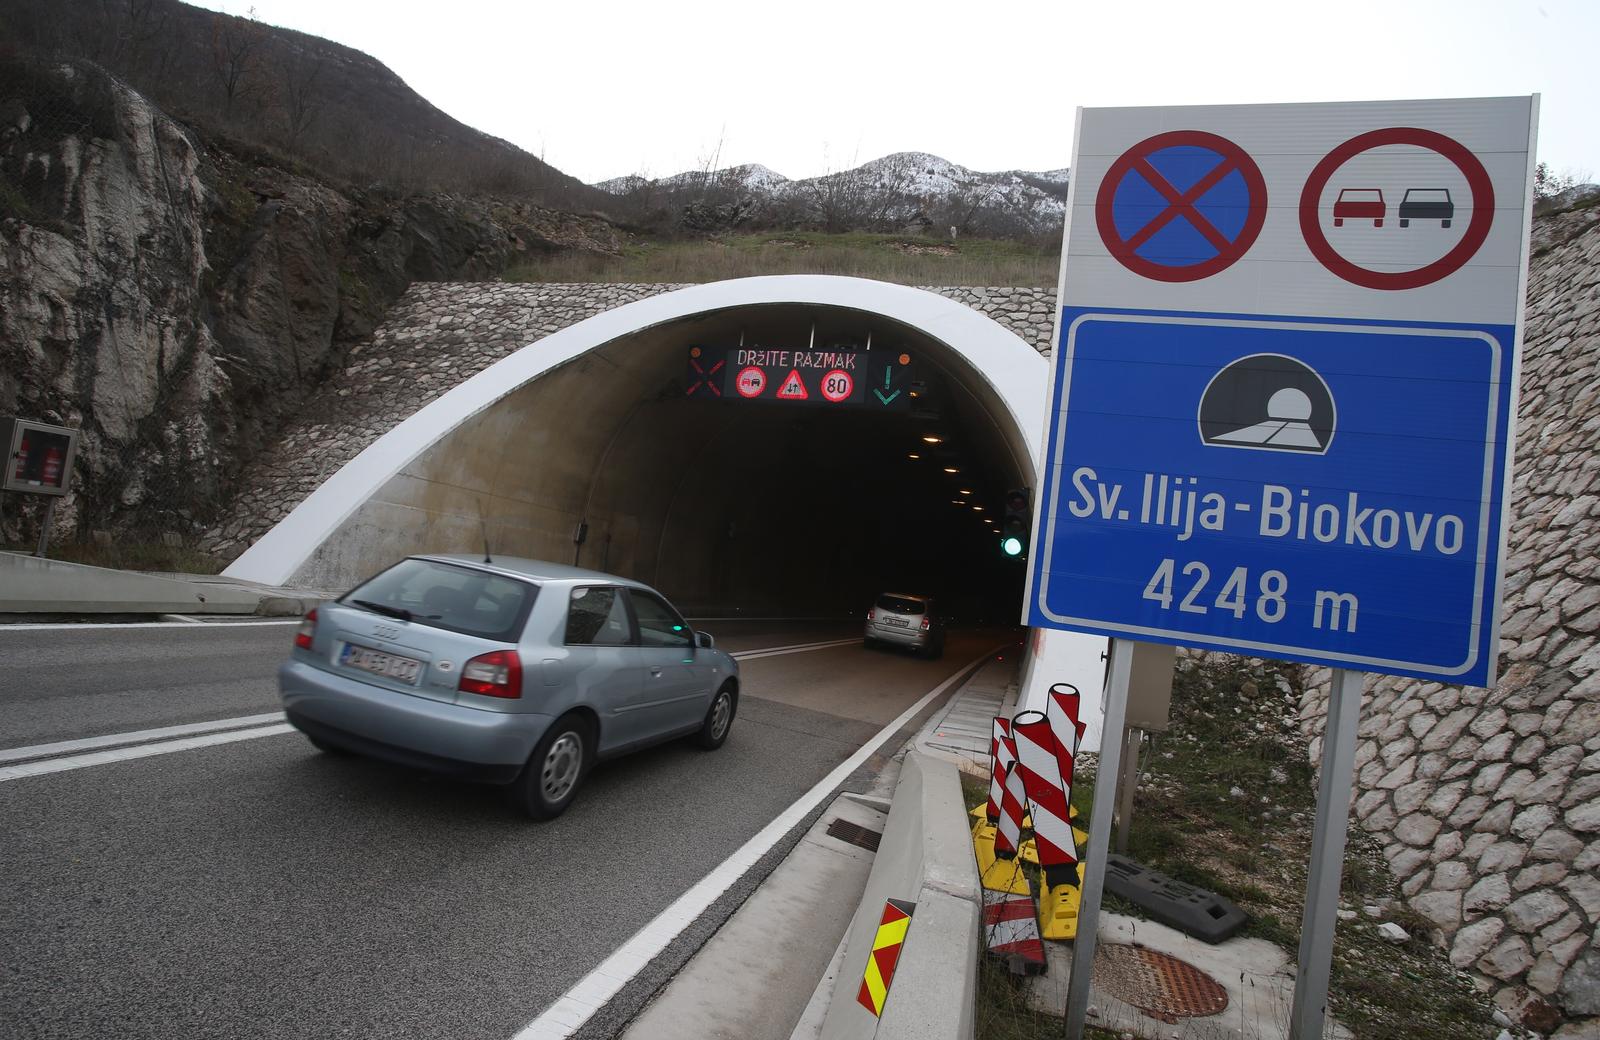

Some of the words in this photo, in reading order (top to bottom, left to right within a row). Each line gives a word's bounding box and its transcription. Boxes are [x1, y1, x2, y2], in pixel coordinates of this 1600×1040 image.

[794, 352, 856, 369] RAZMAK
[827, 379, 847, 394] 80
[1069, 468, 1128, 519] Sv.
[1143, 559, 1287, 622] 4248
[1313, 591, 1357, 632] m
